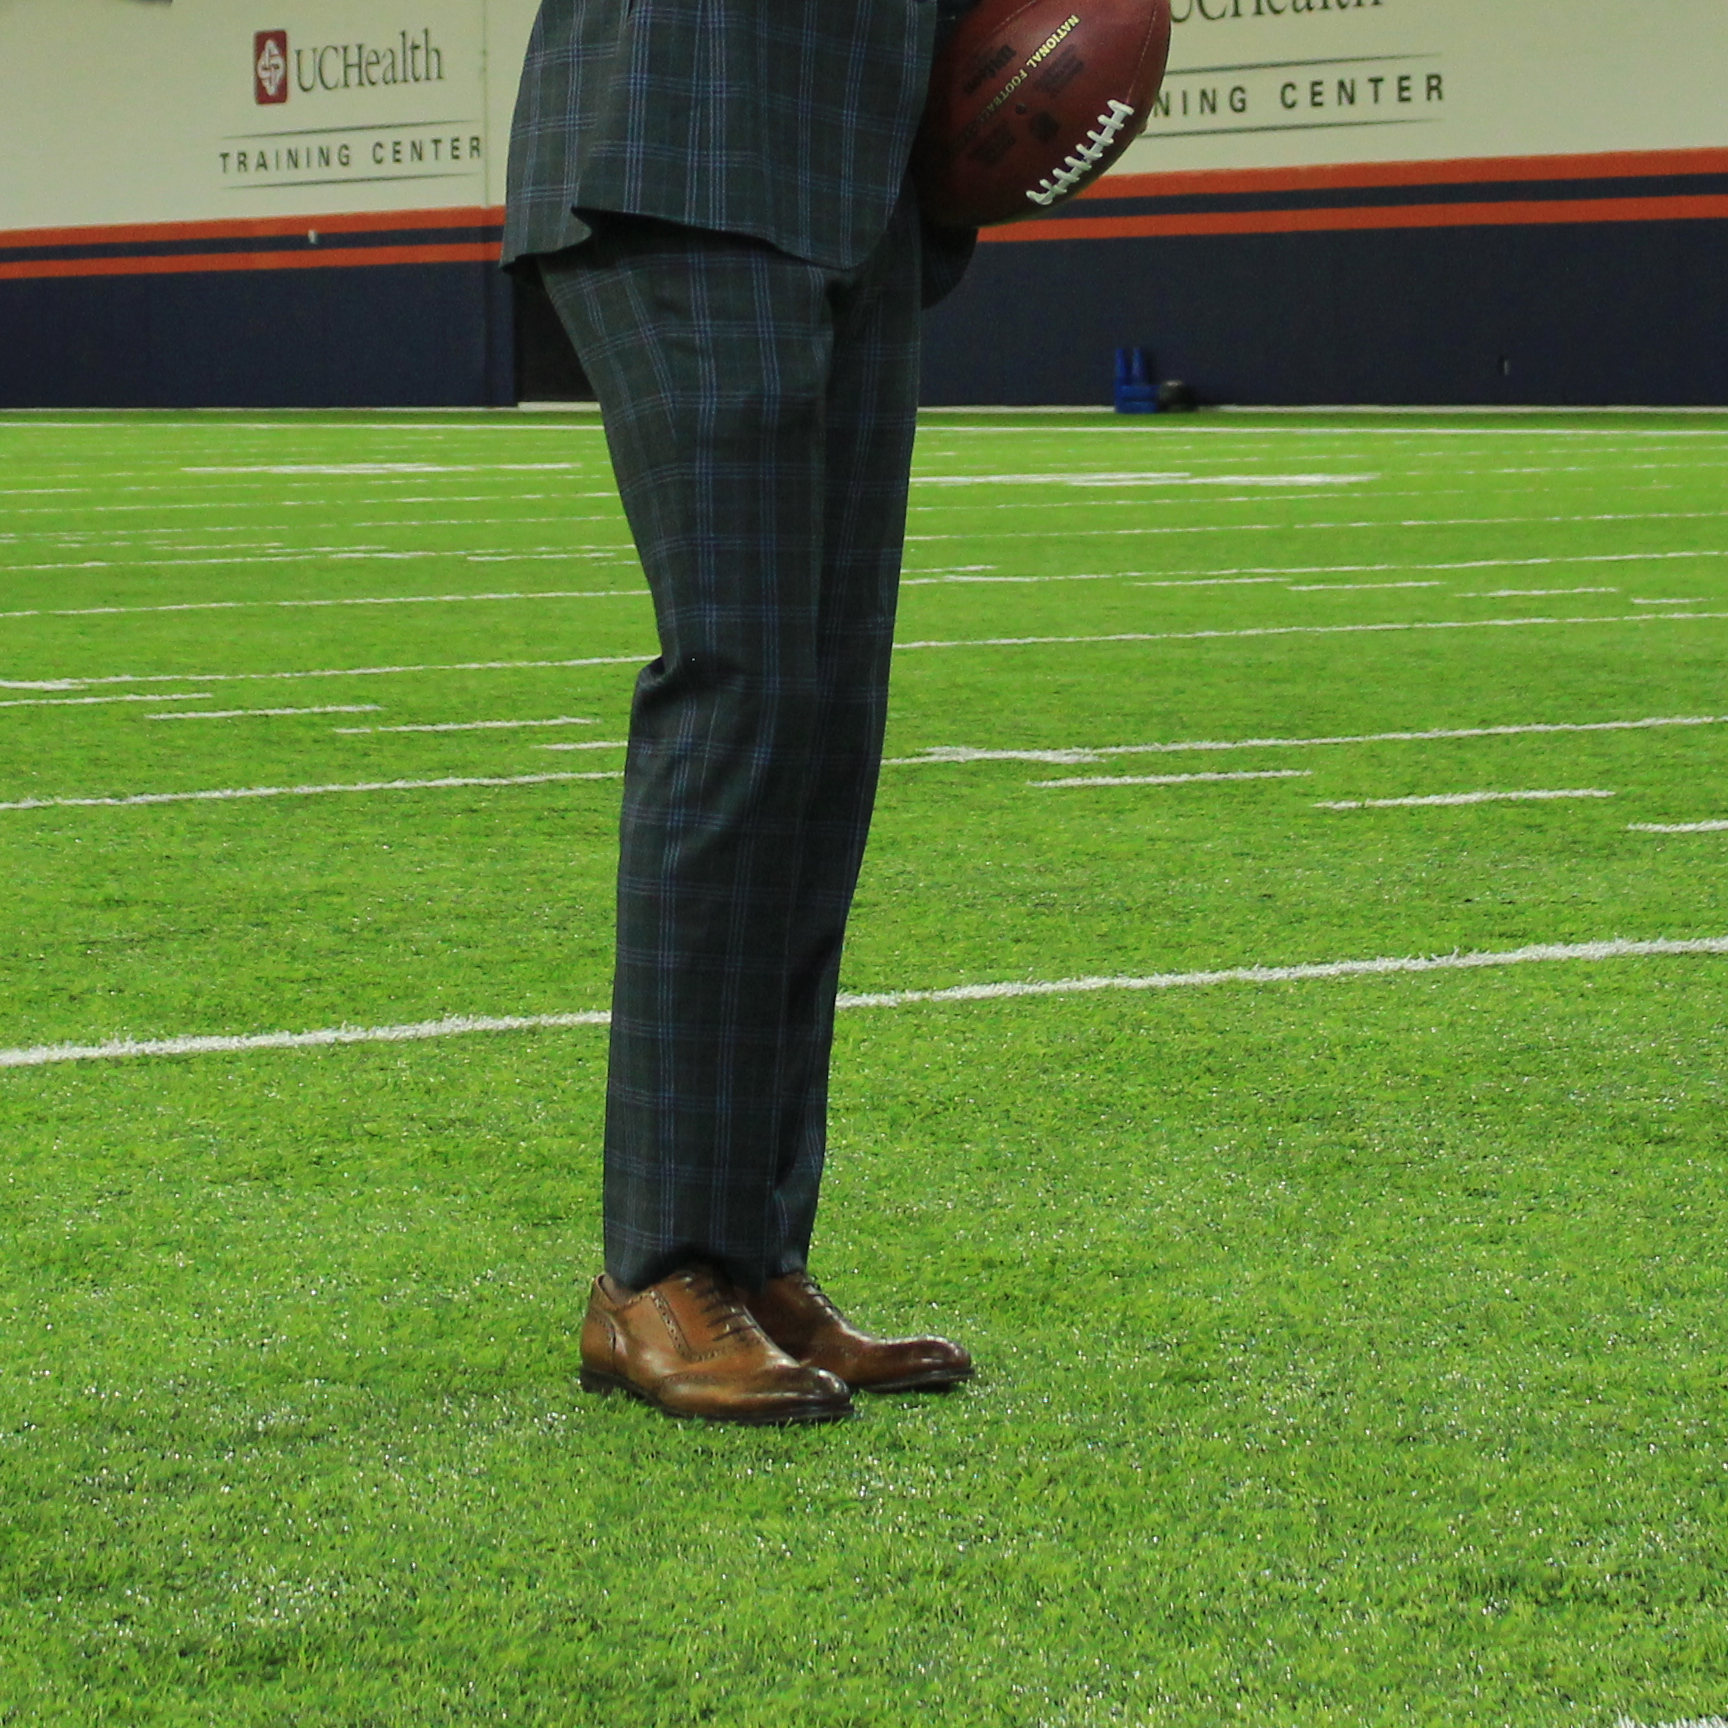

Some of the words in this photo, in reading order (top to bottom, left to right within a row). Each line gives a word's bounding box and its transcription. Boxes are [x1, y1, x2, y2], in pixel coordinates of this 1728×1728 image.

[294, 27, 445, 94] UCHealth
[1025, 14, 1082, 69] NATIONAL
[1152, 84, 1248, 119] NING
[1280, 73, 1446, 110] CENTER
[219, 143, 352, 174] TRAINING
[371, 135, 482, 165] CENTER
